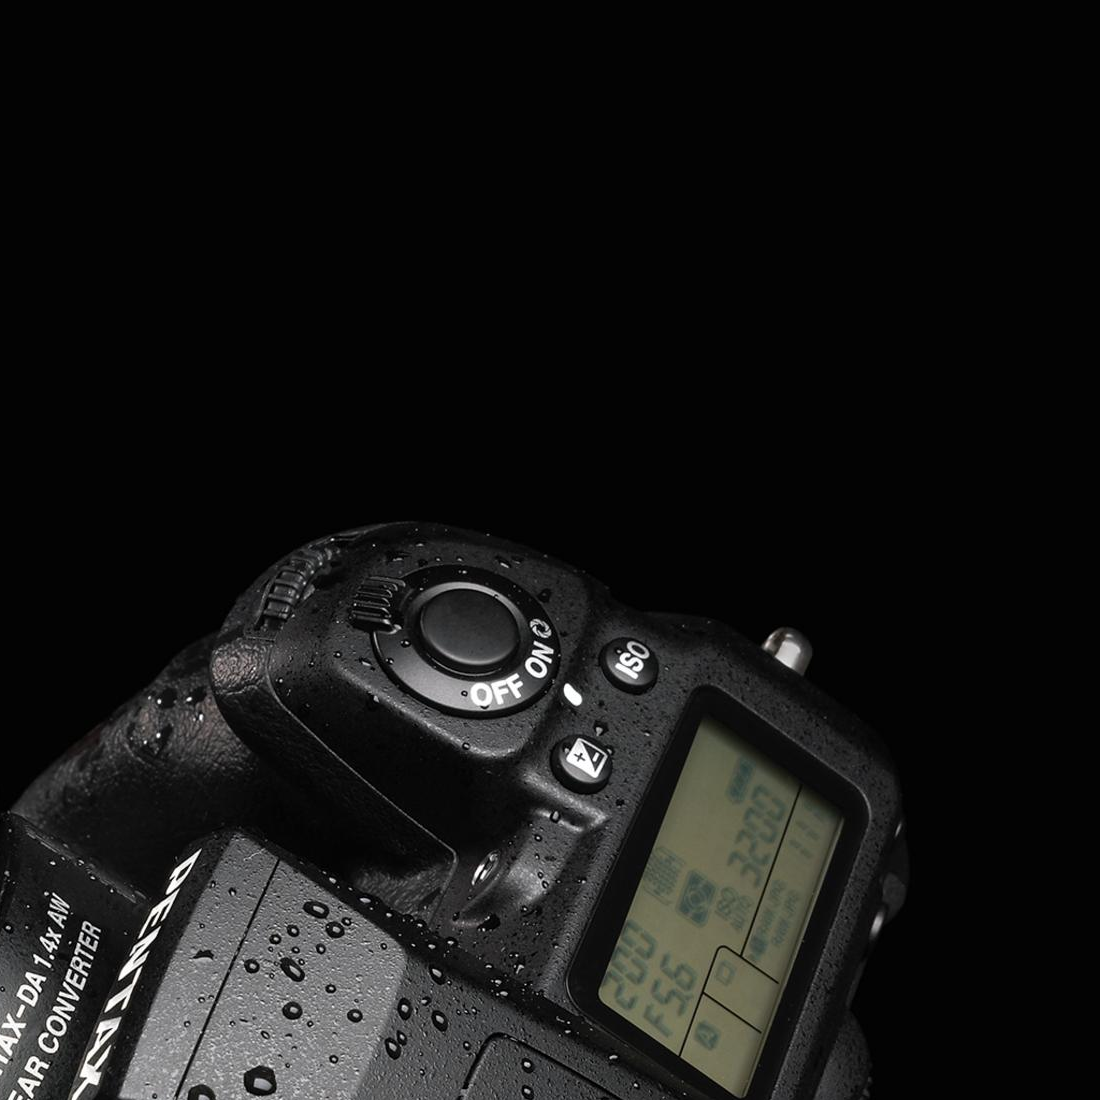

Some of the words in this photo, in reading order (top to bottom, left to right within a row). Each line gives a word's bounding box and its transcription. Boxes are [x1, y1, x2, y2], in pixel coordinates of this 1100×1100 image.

[524, 641, 555, 679] ON
[615, 639, 650, 680] ISO
[470, 673, 524, 707] OFF
[728, 784, 786, 888] 3200
[47, 892, 72, 932] AW
[33, 925, 66, 969] 1.4x
[38, 919, 101, 1055] CONVERTER
